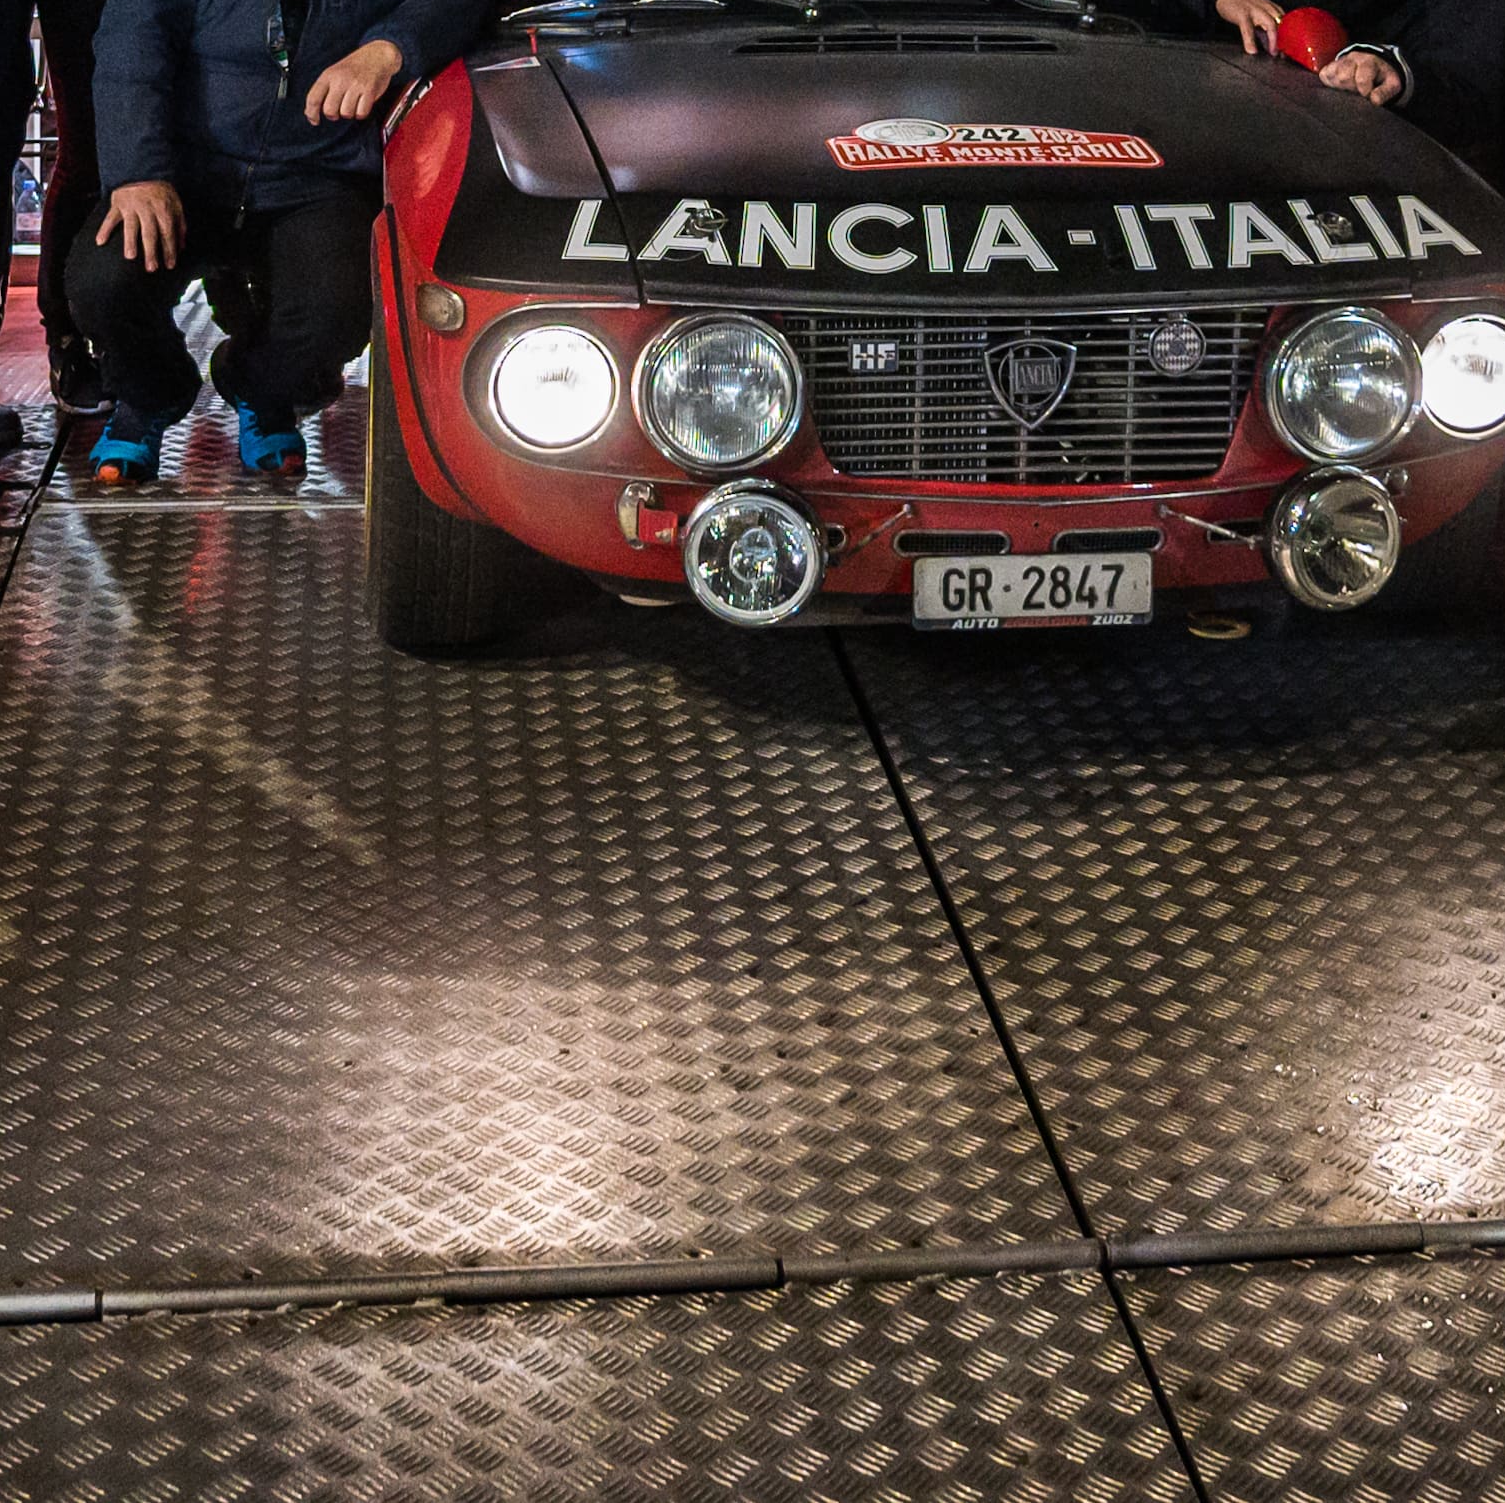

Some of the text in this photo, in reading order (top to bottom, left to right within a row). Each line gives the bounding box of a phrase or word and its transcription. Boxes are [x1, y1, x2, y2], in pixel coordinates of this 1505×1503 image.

[955, 128, 1027, 142] 242
[845, 139, 1147, 162] RALLYE MONTE-CARLO
[851, 342, 897, 371] HF
[1022, 563, 1125, 611] 2847
[952, 618, 999, 630] AUTO
